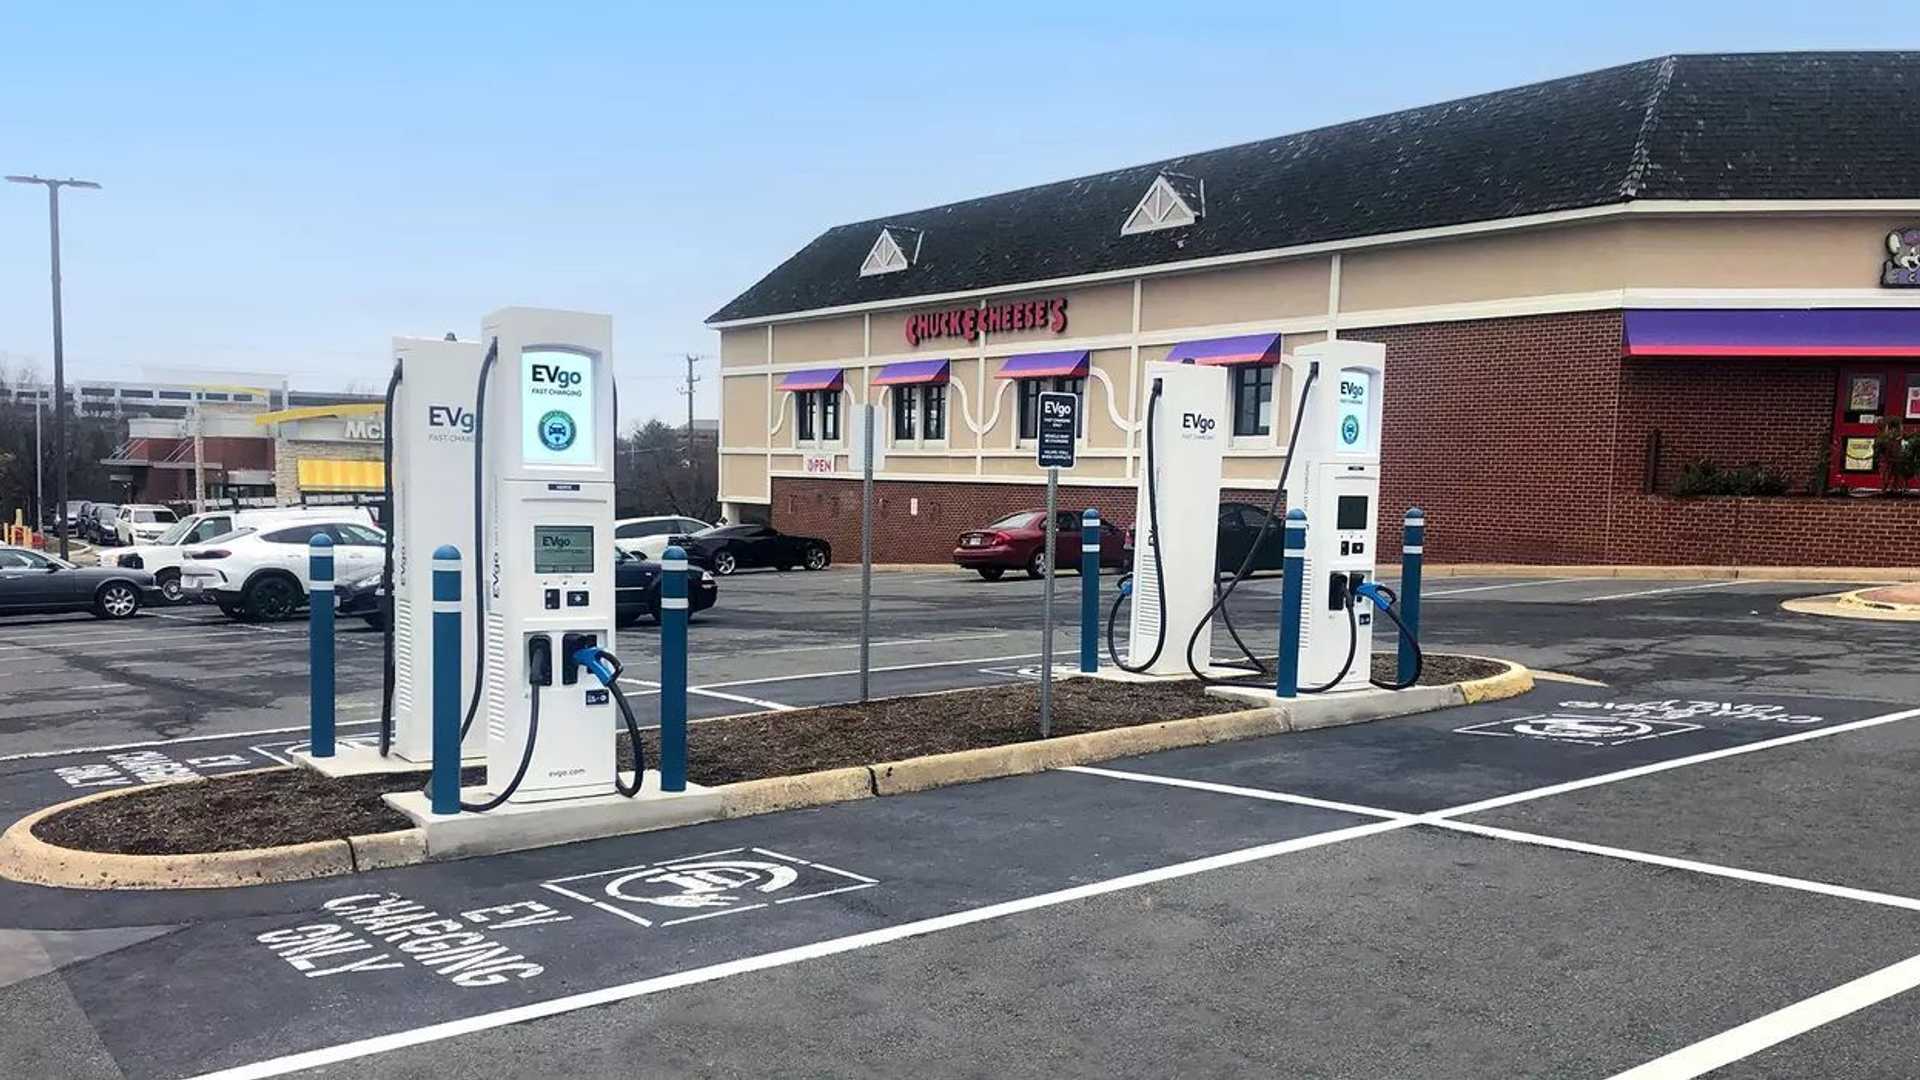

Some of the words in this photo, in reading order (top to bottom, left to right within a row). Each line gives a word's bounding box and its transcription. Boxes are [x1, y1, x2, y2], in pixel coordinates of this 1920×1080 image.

[906, 312, 962, 345] CHUCK
[977, 296, 1067, 333] CHEESE'S
[532, 364, 582, 388] EVgo
[1341, 381, 1364, 398] EVgo
[429, 406, 474, 433] EVg
[1045, 401, 1071, 417] EVgo
[345, 420, 384, 439] Mc
[1183, 413, 1216, 434] EVgo
[807, 459, 832, 473] OPEN
[542, 536, 572, 547] EVgo
[460, 901, 573, 930] EV
[256, 924, 404, 978] ONLY
[322, 893, 544, 987] CHARGING
